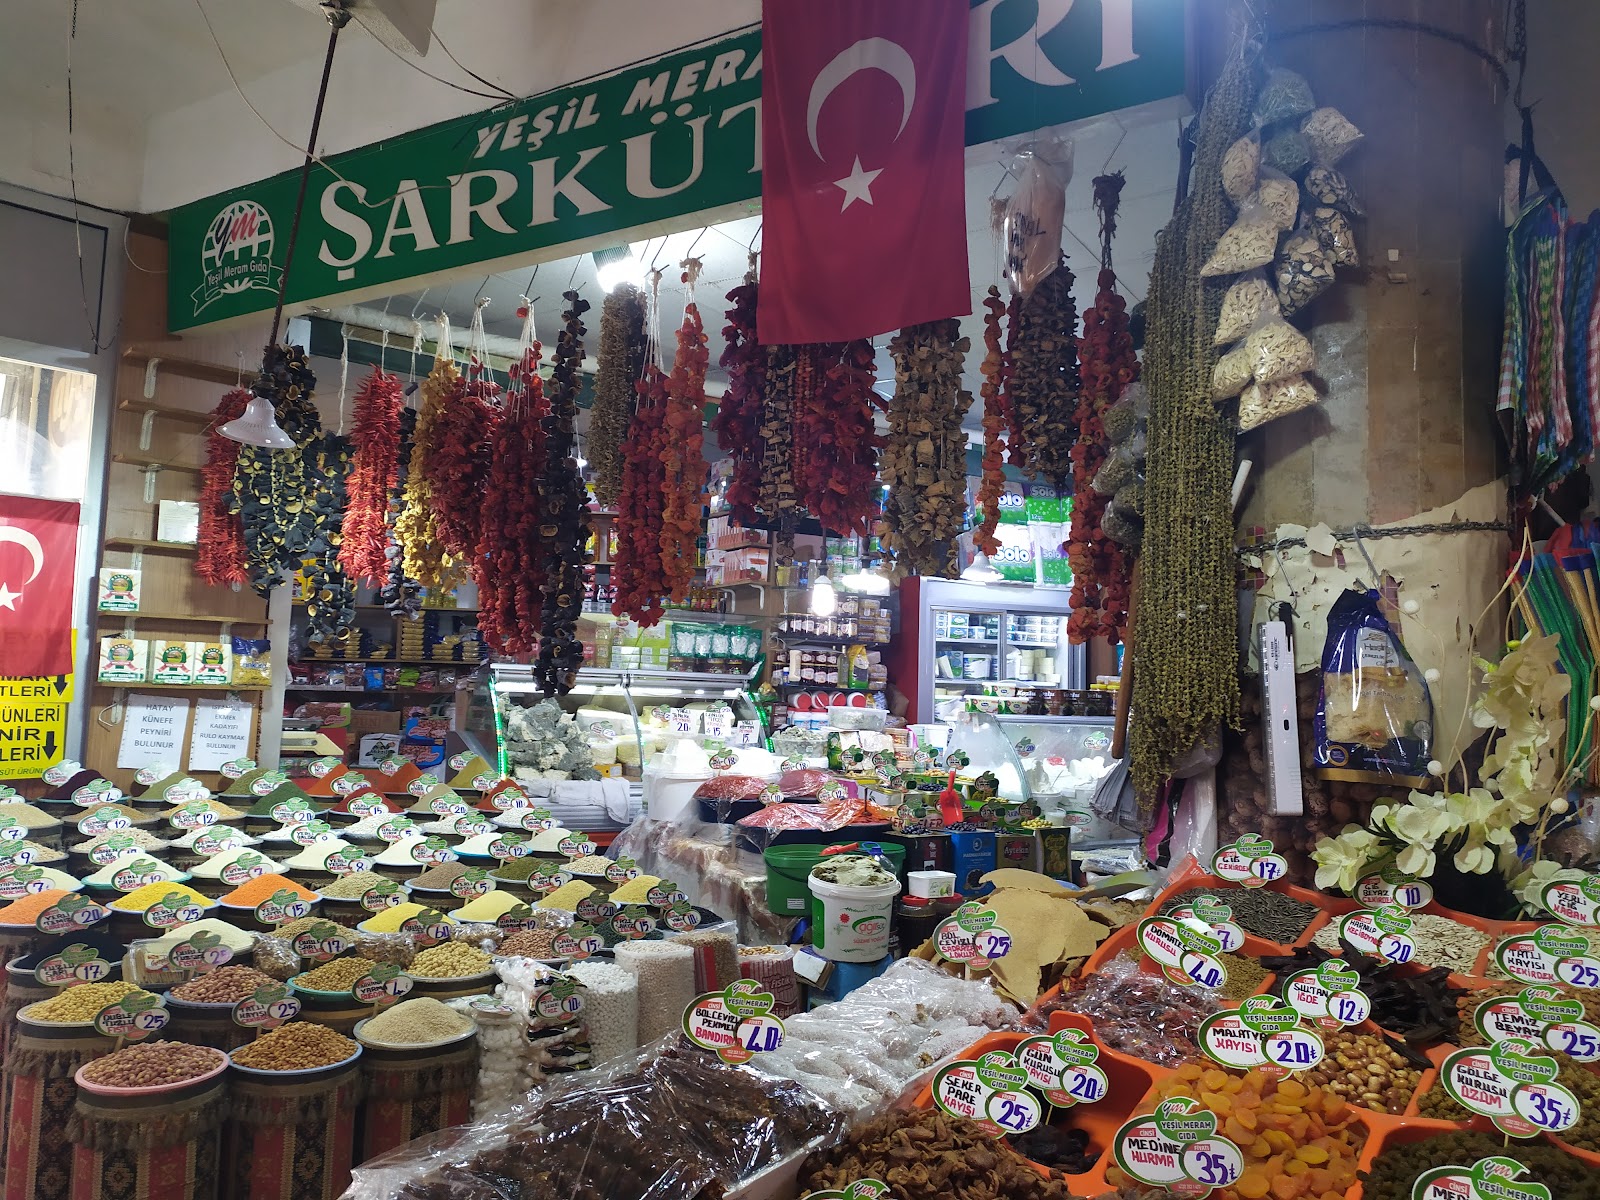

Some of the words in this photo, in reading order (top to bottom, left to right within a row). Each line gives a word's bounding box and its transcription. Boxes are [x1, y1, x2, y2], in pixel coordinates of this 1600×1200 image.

[474, 92, 601, 159] YEŞİL
[208, 269, 222, 286] Yeşil
[224, 265, 248, 277] Meram
[250, 260, 267, 272] Gıda
[1030, 486, 1056, 497] Solo
[997, 491, 1023, 507] olo
[142, 715, 174, 725] KÜNEFE
[140, 727, 172, 737] PEYNİRİ
[134, 740, 174, 749] BULUNUR
[1406, 887, 1421, 906] 10
[1554, 904, 1587, 922] KABAK
[1145, 931, 1177, 956] KURUSU
[1150, 925, 1187, 951] DOMATES
[1508, 949, 1541, 960] TATLI
[1508, 958, 1545, 970] KAYISI
[1293, 983, 1328, 997] SULTAN
[745, 1000, 768, 1008] MERAM
[738, 1008, 754, 1016] GIDA
[1246, 1014, 1266, 1022] YEŞİL
[1542, 1014, 1561, 1022] GIDA
[1491, 1012, 1540, 1027] TEMİZ
[1212, 1028, 1267, 1041] MALATYA
[1056, 1044, 1072, 1053] YEŞİL
[1072, 1049, 1094, 1058] MERAM
[1214, 1038, 1257, 1053] KAYISI
[1065, 1055, 1079, 1063] GIDA
[1496, 1057, 1519, 1069] YEŞİL
[1520, 1062, 1552, 1075] MERAM
[980, 1069, 998, 1078] YEŞİL
[998, 1073, 1024, 1082] MERAM
[1512, 1071, 1533, 1082] GIDA
[991, 1081, 1008, 1089] GIDA
[948, 1087, 976, 1105] PARE
[943, 1095, 975, 1116] KAYISI
[1161, 1119, 1183, 1130] YEŞİL
[1183, 1121, 1212, 1129] MERAM
[1178, 1132, 1197, 1140] GIDA
[1128, 1138, 1181, 1155] MEDİNE
[1132, 1151, 1175, 1168] HURMA
[1478, 1180, 1504, 1194] YEŞİL
